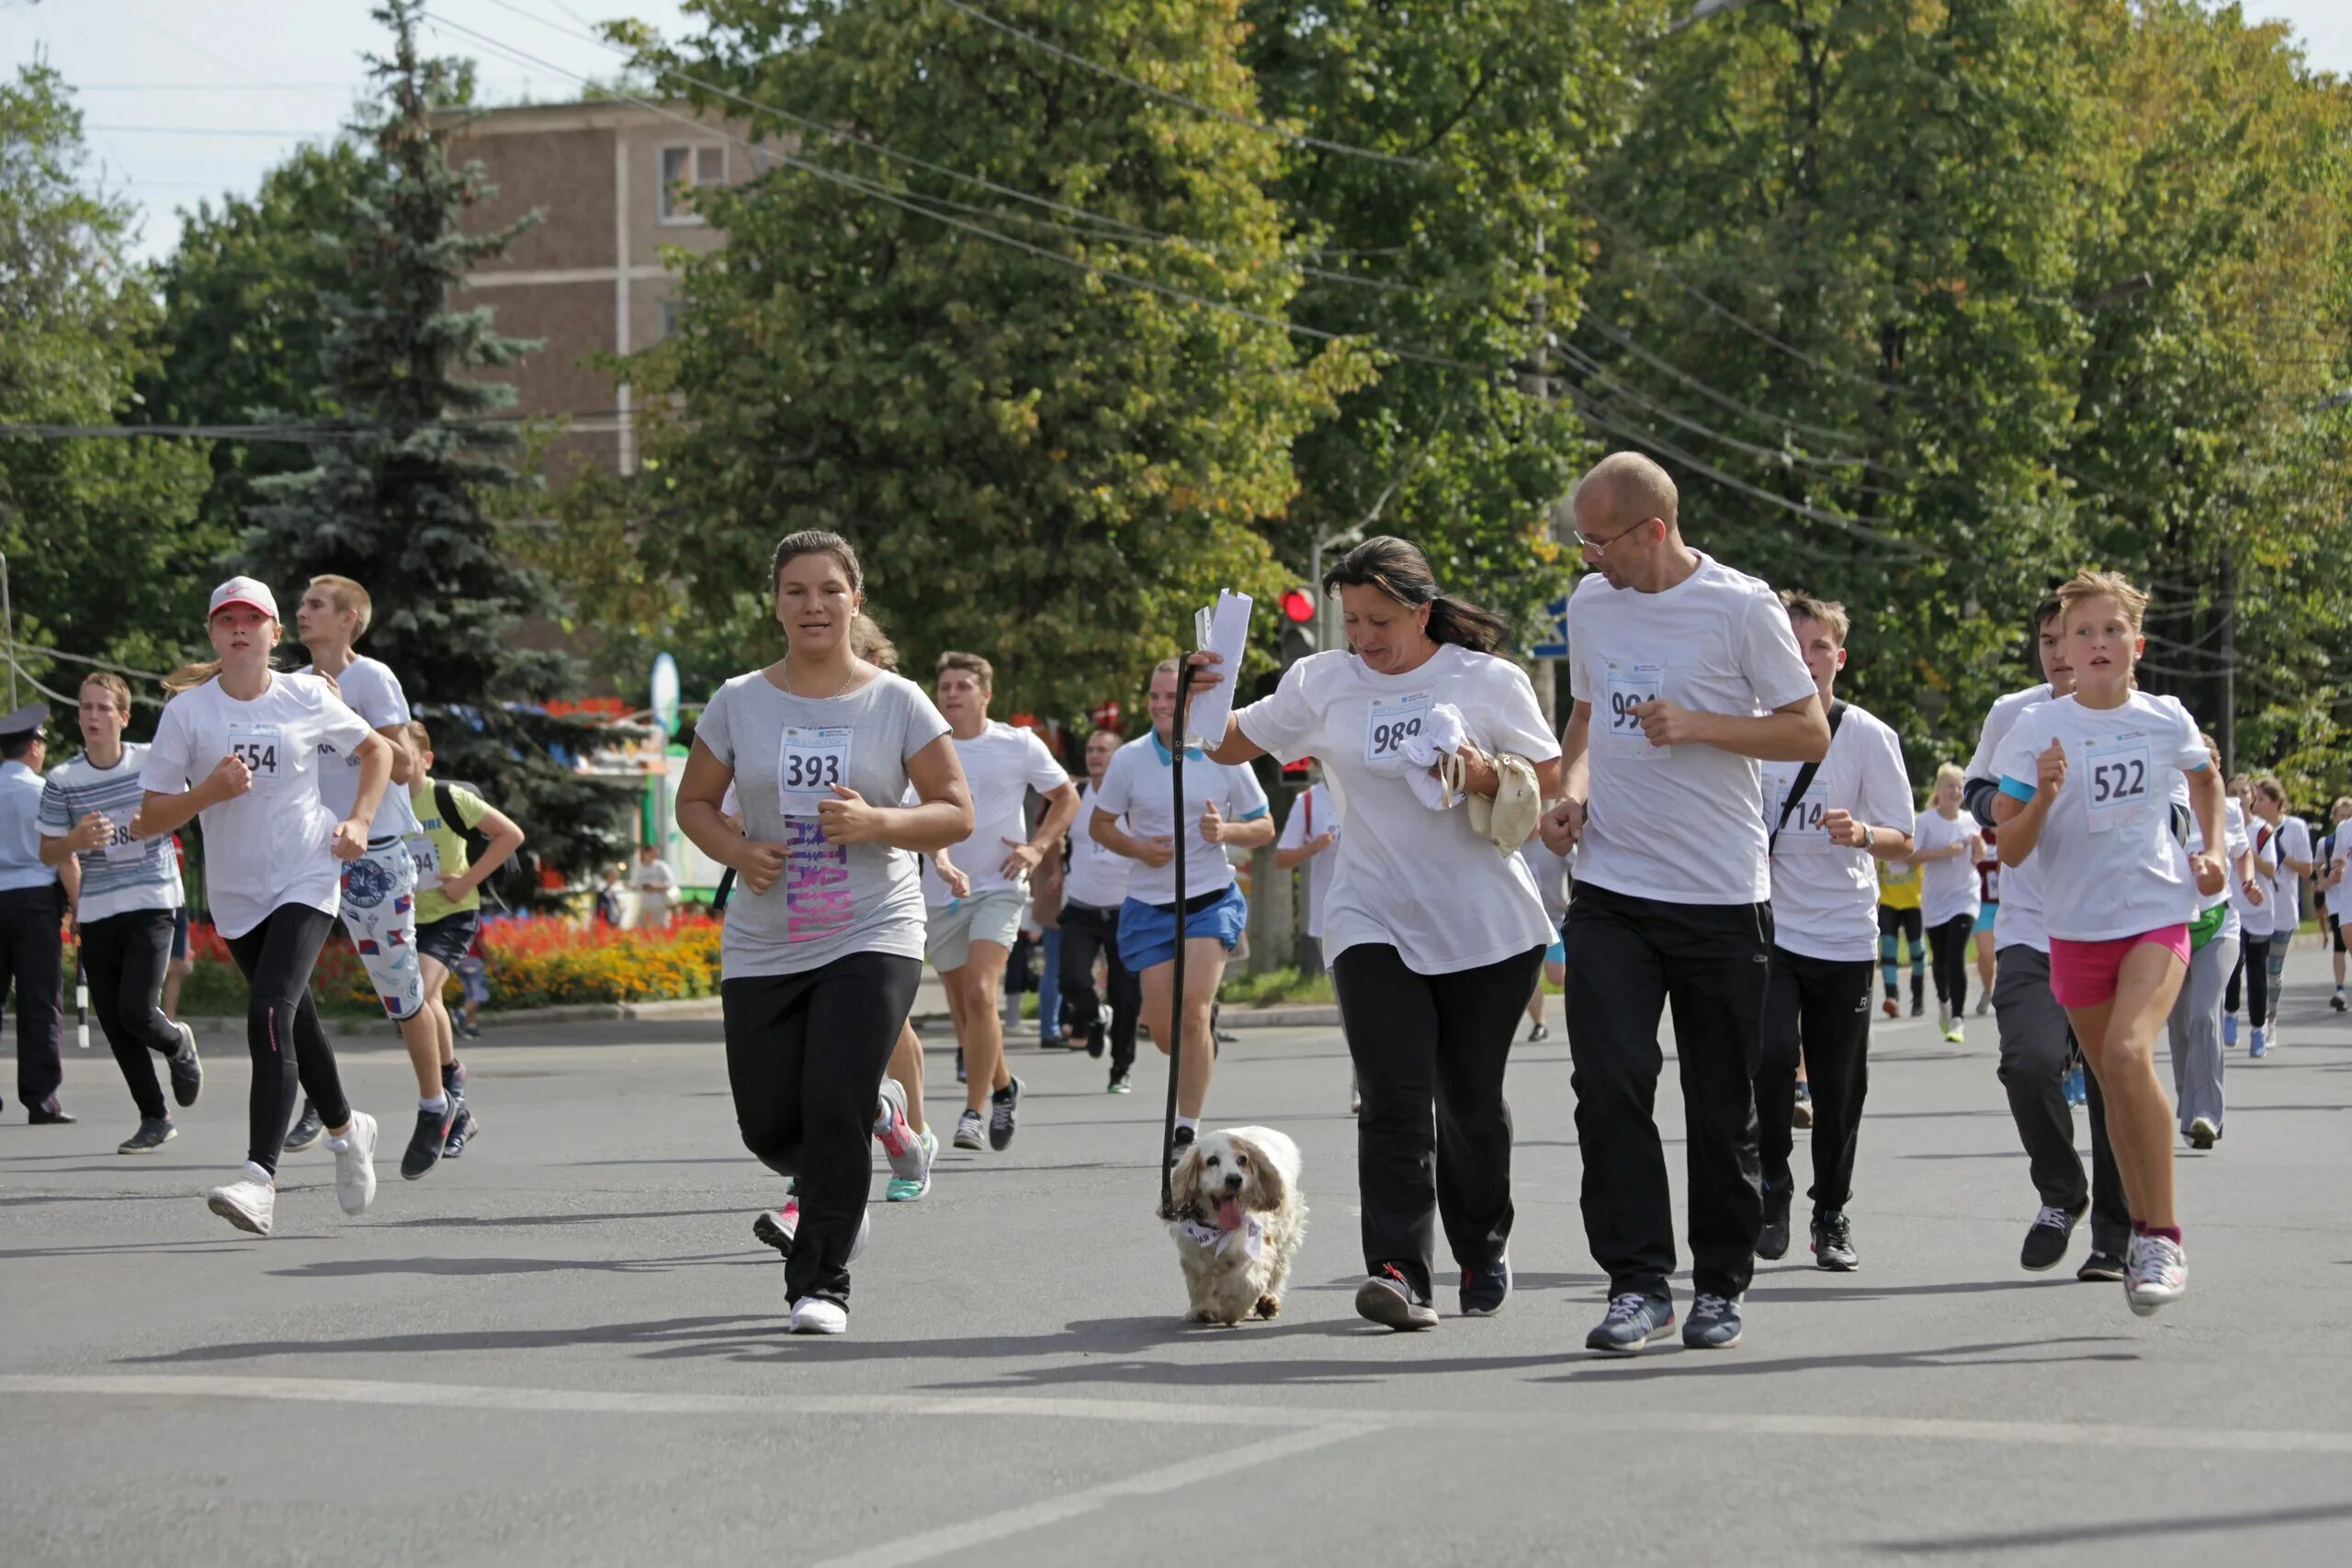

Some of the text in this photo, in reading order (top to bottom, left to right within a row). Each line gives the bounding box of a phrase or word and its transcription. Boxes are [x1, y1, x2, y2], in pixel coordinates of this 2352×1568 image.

[1612, 692, 1656, 728] 99
[1374, 717, 1421, 754] 989
[233, 744, 277, 773] 554
[787, 755, 839, 787] 393
[2095, 760, 2144, 802] 522
[110, 826, 138, 845] 38
[413, 852, 434, 874] 94
